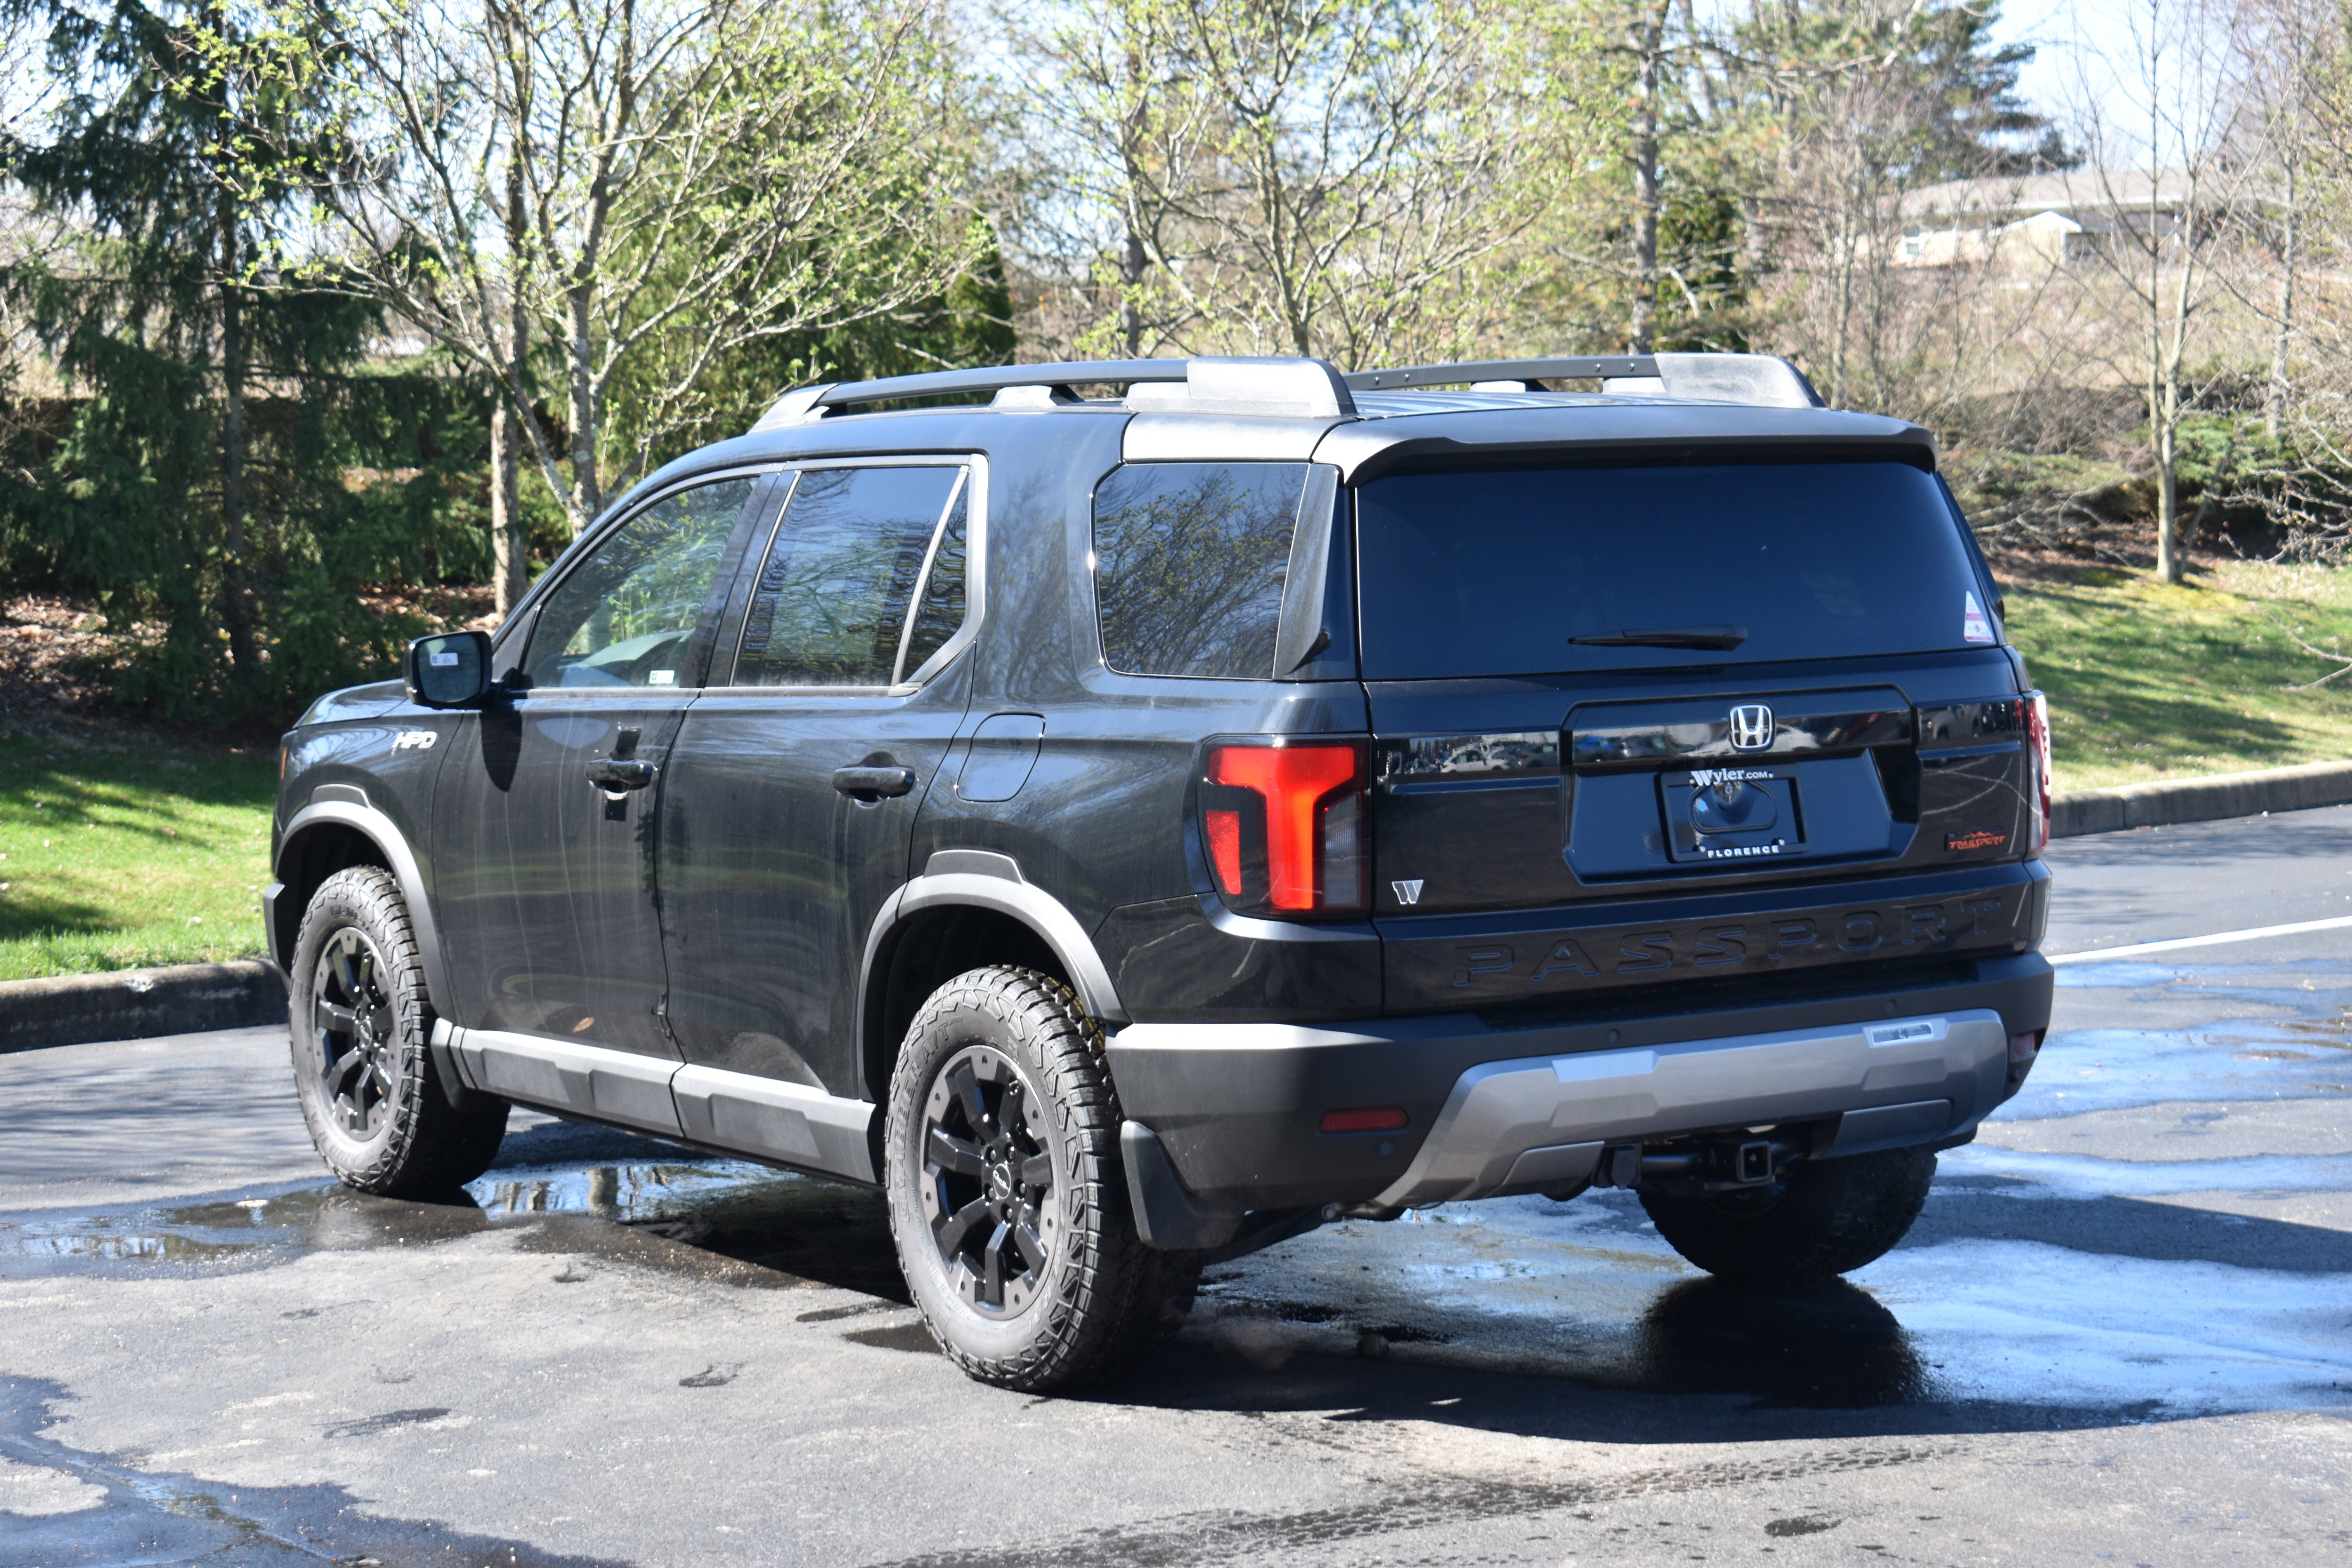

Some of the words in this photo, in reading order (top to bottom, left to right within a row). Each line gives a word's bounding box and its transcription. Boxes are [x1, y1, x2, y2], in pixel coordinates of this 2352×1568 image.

[392, 731, 438, 748] HPD
[1708, 845, 1780, 858] FLORENCE
[1949, 836, 2006, 850] TRAILSPORT
[1454, 897, 2001, 987] PASSPORT
[895, 1059, 922, 1221] GRABBER
